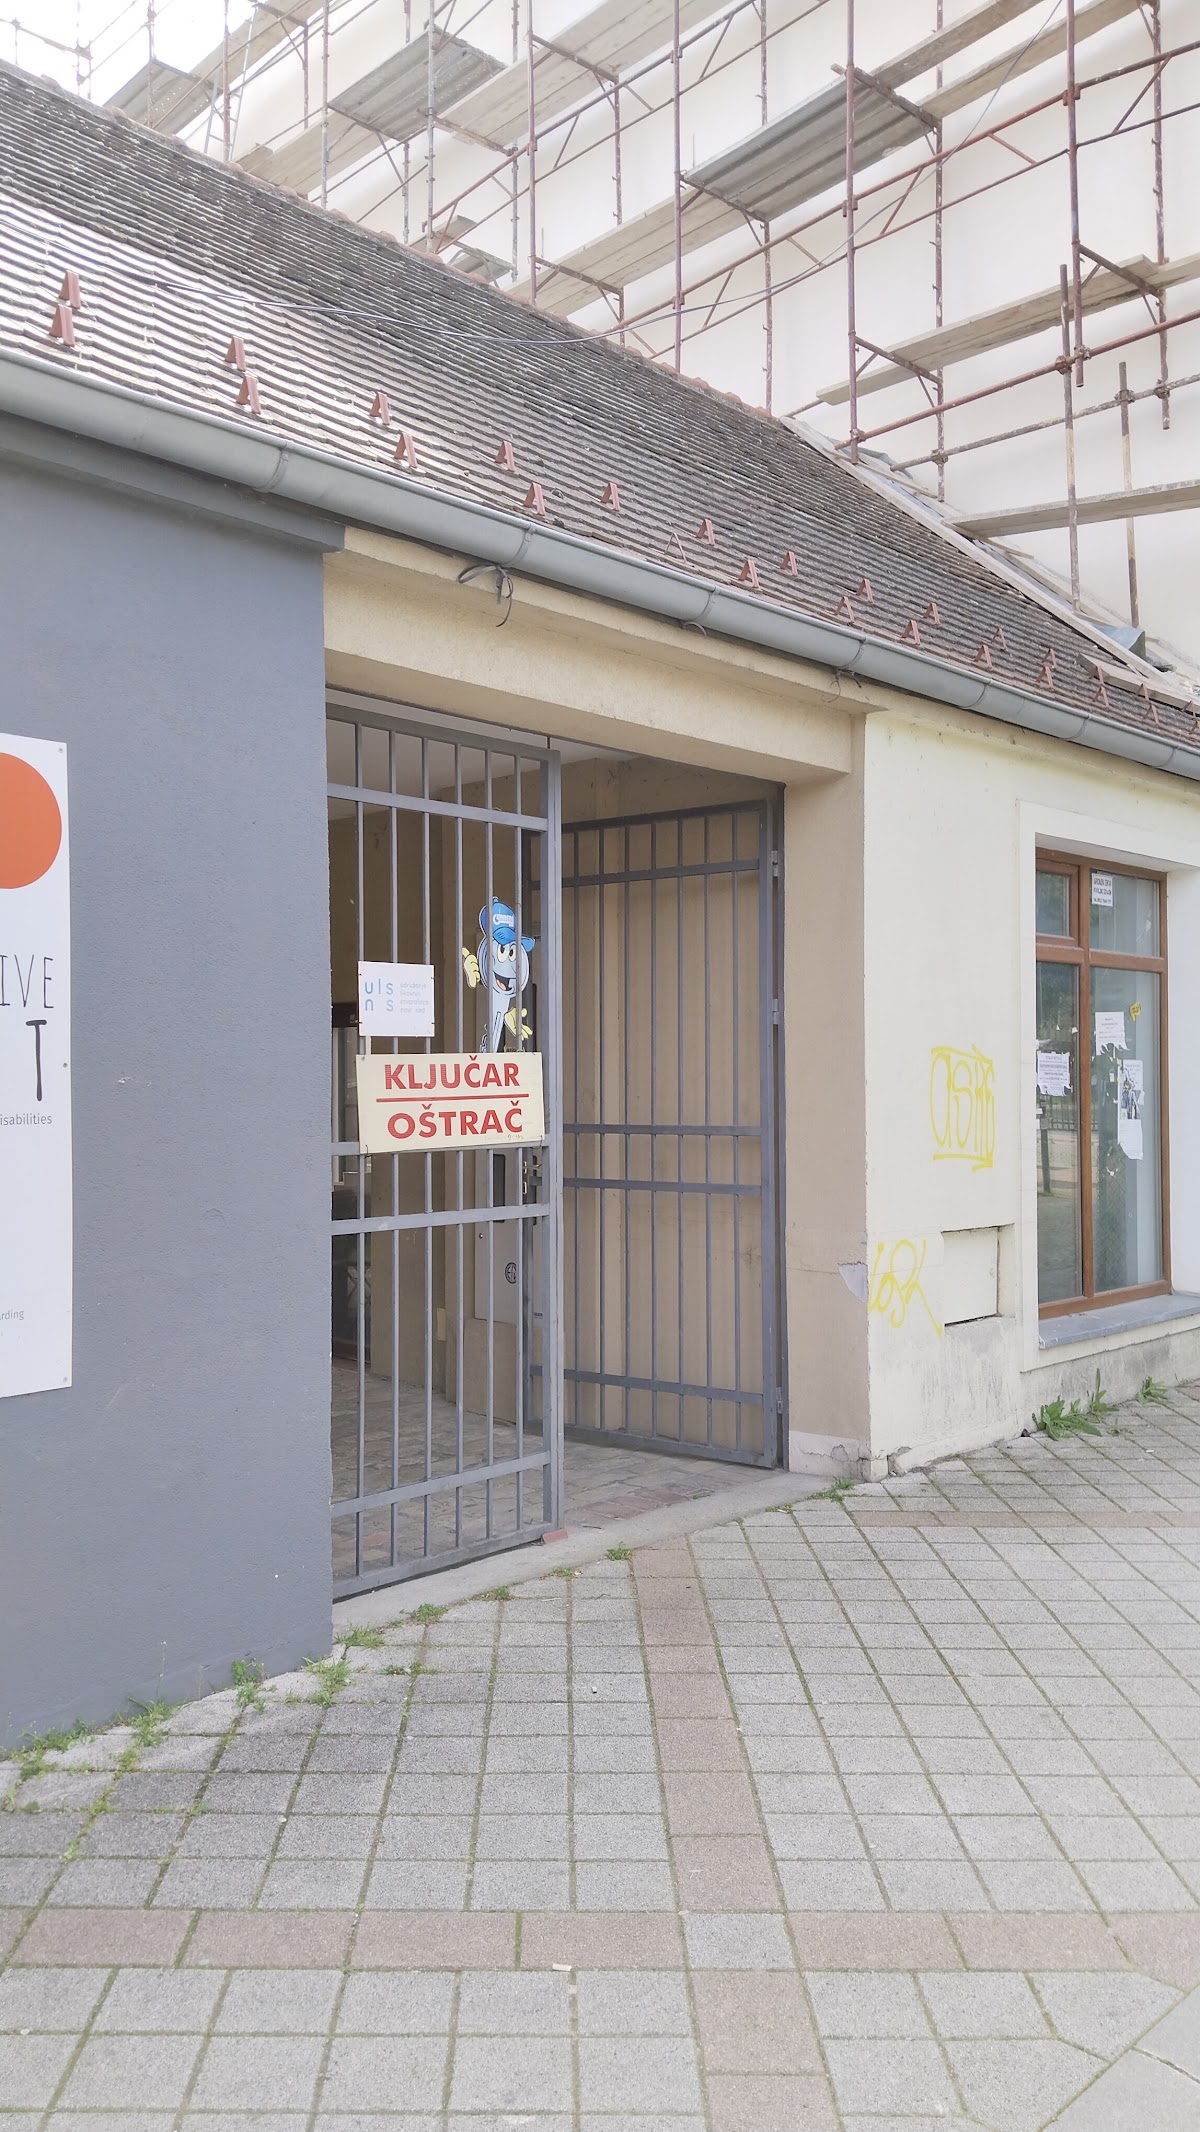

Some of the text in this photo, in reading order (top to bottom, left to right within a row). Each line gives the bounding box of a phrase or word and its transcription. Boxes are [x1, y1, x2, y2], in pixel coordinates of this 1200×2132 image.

[384, 1055, 520, 1090] KLJUČAR
[387, 1100, 523, 1140] OŠTRAČ
[0, 1309, 25, 1321] rding
